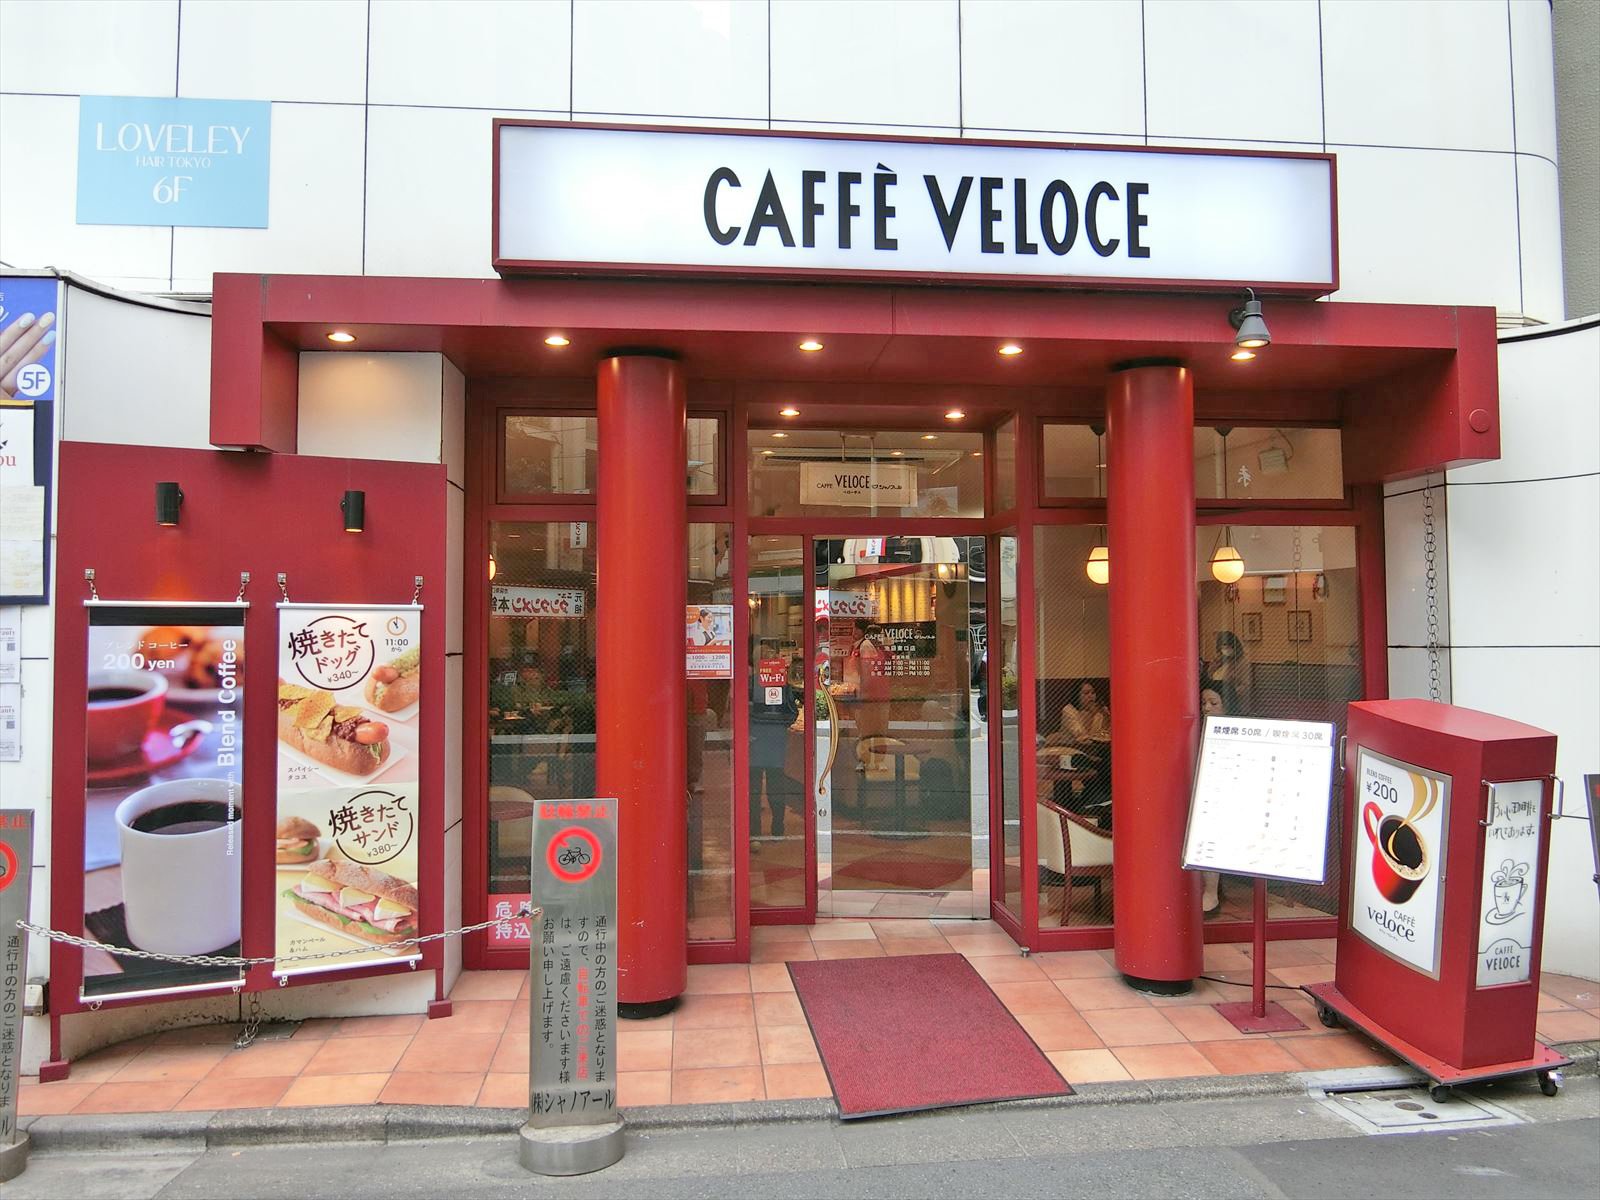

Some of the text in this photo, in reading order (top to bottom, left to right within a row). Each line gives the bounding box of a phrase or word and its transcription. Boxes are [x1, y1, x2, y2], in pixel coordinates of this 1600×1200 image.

[96, 122, 250, 154] LOVELEY
[136, 156, 211, 169] HAIR TOKYO
[153, 175, 192, 204] 6F
[703, 162, 1150, 258] CAFFÈ VELOCE
[22, 372, 45, 389] 5F
[835, 474, 870, 489] VELOCE
[288, 622, 370, 661] 焼きたて
[385, 638, 409, 646] 11:00
[103, 653, 175, 671] 200 yen
[315, 645, 361, 674] ドッグ
[217, 639, 237, 767] Blend Coffee
[1366, 780, 1398, 804] ¥200
[328, 796, 408, 838] 焼きたて
[352, 821, 399, 849] サンド
[1367, 904, 1416, 943] veloce
[1486, 955, 1521, 971] VELOCE
